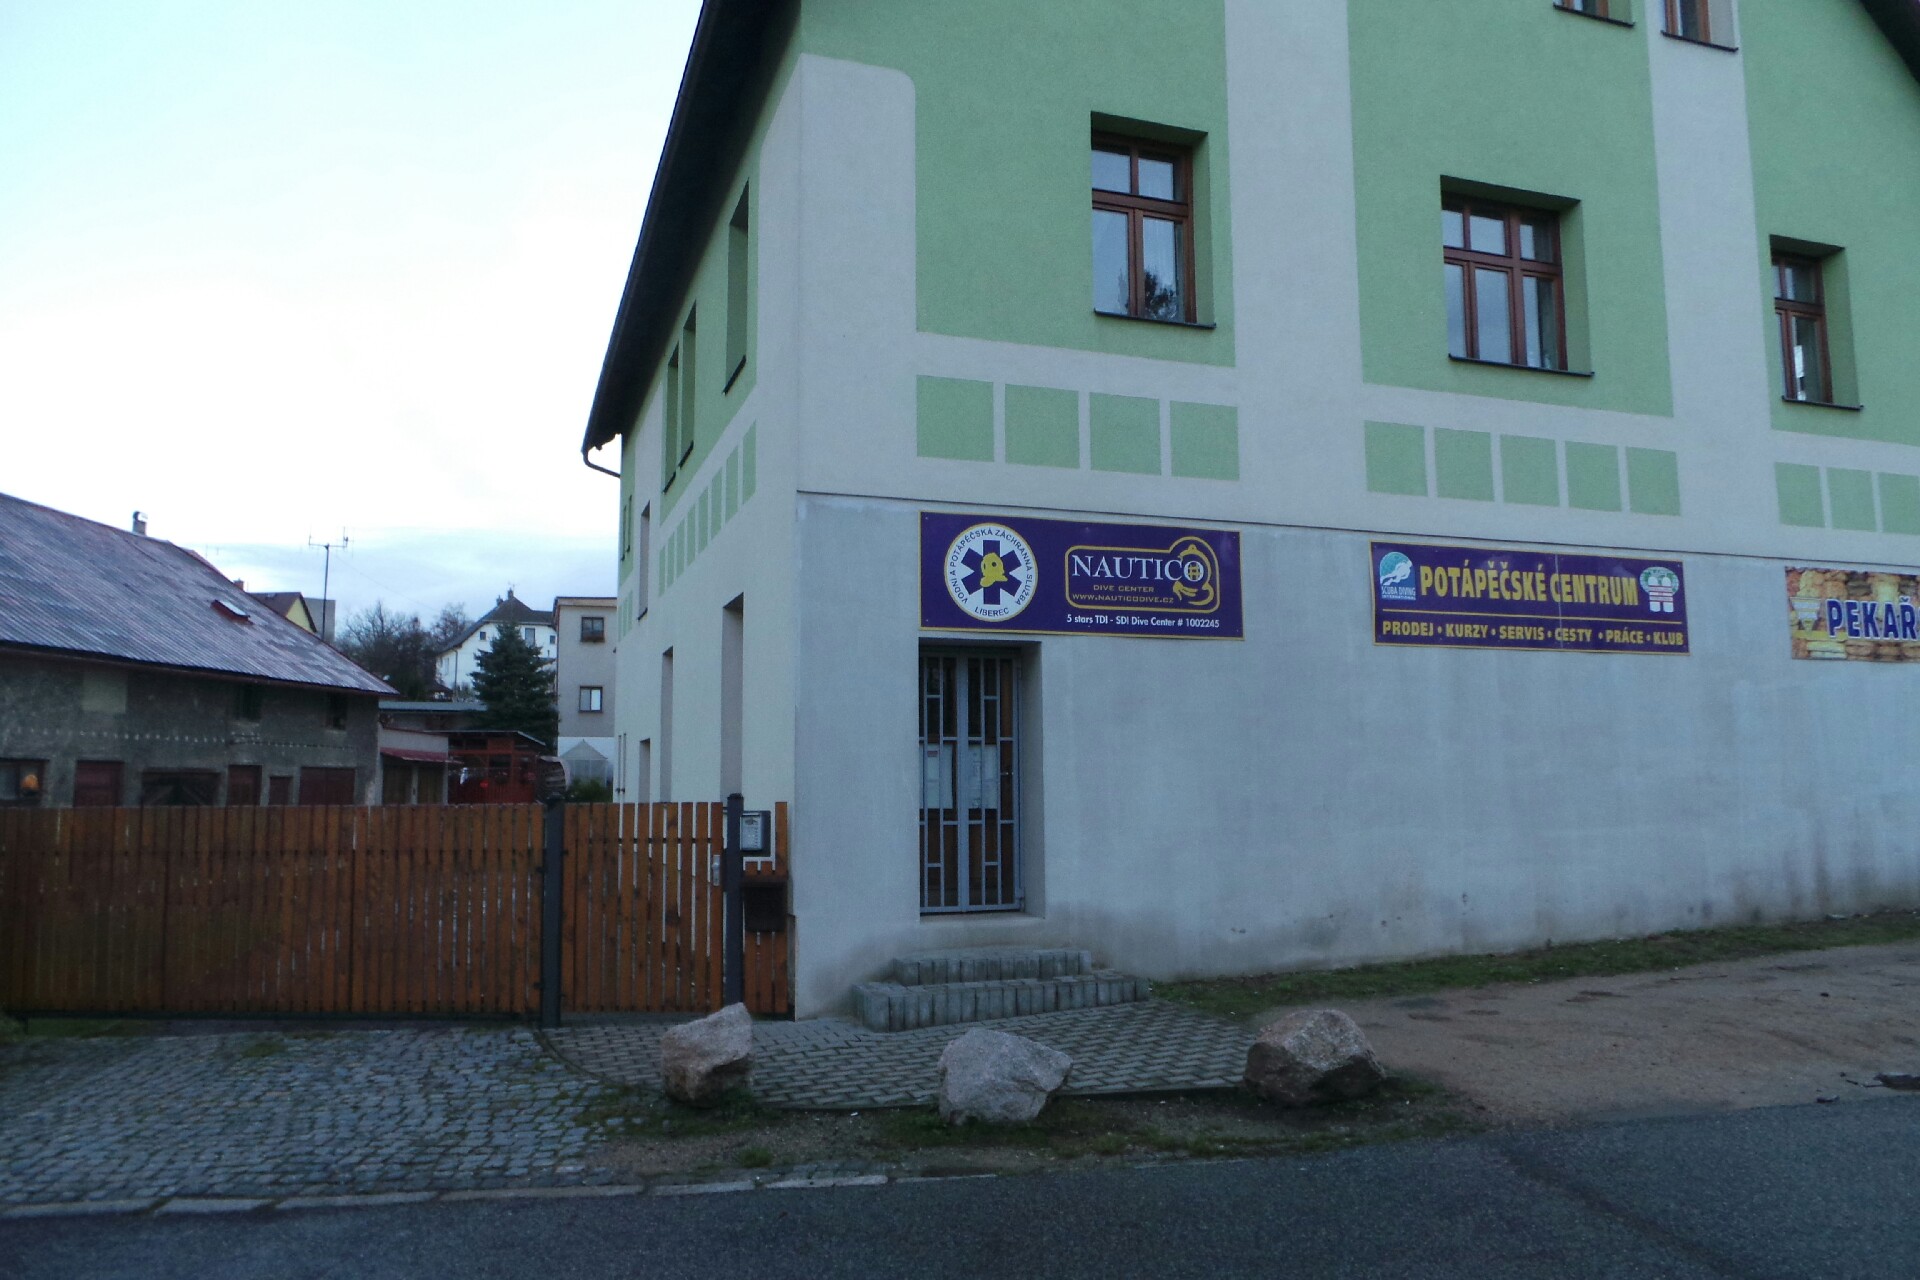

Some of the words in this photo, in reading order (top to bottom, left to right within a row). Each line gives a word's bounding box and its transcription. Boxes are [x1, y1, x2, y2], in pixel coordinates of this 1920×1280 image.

[1071, 554, 1204, 582] NAUTICO
[1093, 584, 1115, 592] DIVE
[1118, 585, 1155, 593] CENTER
[1420, 560, 1547, 601] POTÁPĚČSKÉ
[1550, 574, 1638, 606] CENTRUM
[974, 606, 1009, 617] LIBEREC
[1066, 614, 1073, 623] 5
[1074, 615, 1094, 624] stars
[1095, 614, 1108, 625] TDI
[1116, 616, 1130, 626] SDI
[1131, 616, 1149, 626] Dive
[1150, 616, 1176, 627] Center
[1186, 618, 1220, 628] 1002245
[1826, 596, 1920, 641] PEKAŘ
[1382, 620, 1434, 637] PRODEJ
[1446, 623, 1488, 638] KURZY
[1500, 625, 1544, 641] SERVIS
[1554, 628, 1592, 642] CESTY
[1606, 626, 1644, 644] PRÁCE
[1653, 631, 1684, 646] KLUB
